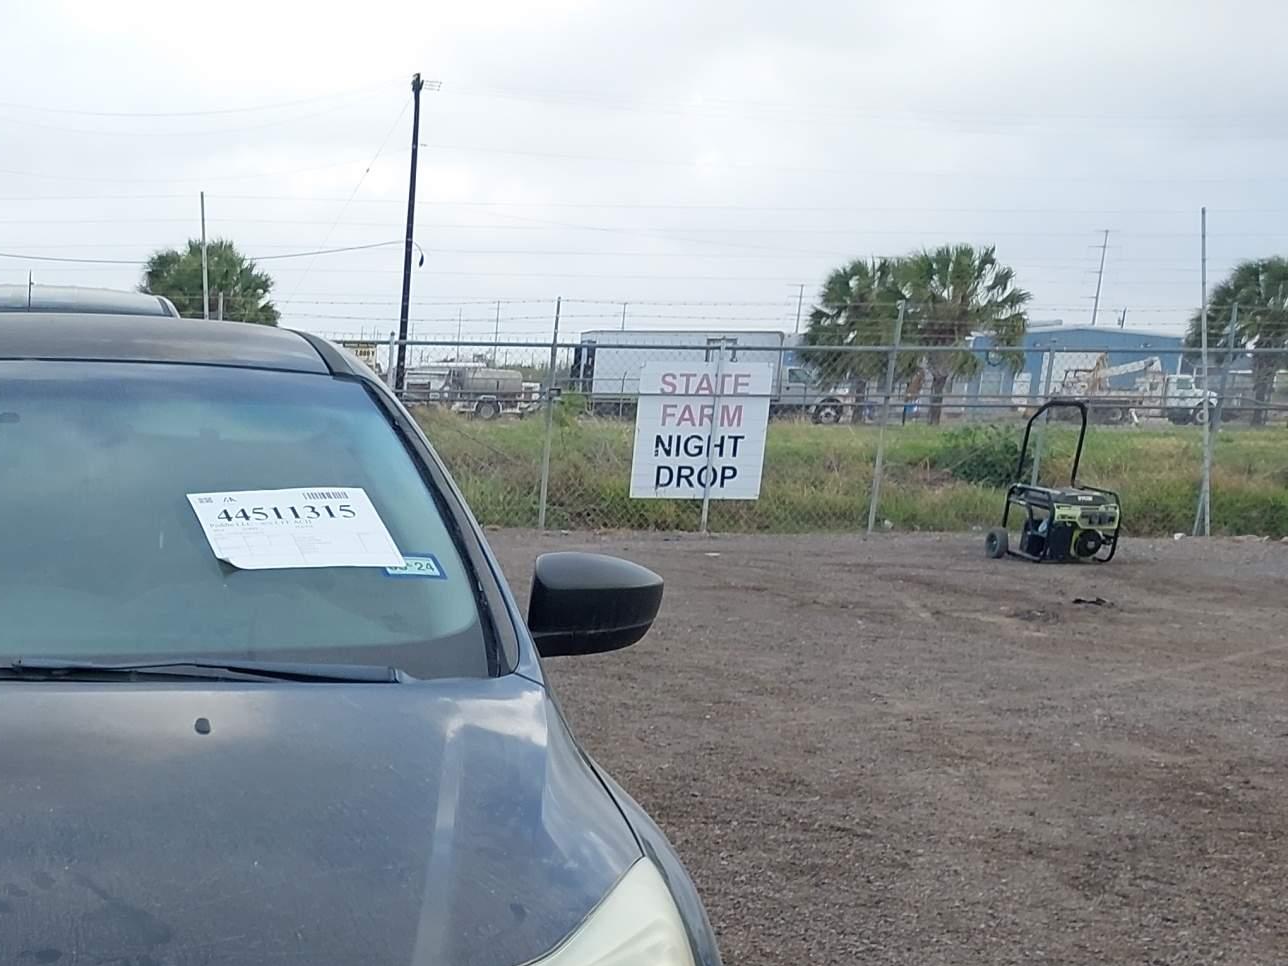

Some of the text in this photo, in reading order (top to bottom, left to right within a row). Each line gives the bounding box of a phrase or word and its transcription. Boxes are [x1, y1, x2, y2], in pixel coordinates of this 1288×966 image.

[660, 373, 751, 396] STATE
[661, 404, 743, 427] FARM
[654, 434, 745, 458] NIGHT
[655, 465, 737, 489] DROP
[217, 505, 356, 521] 44511315
